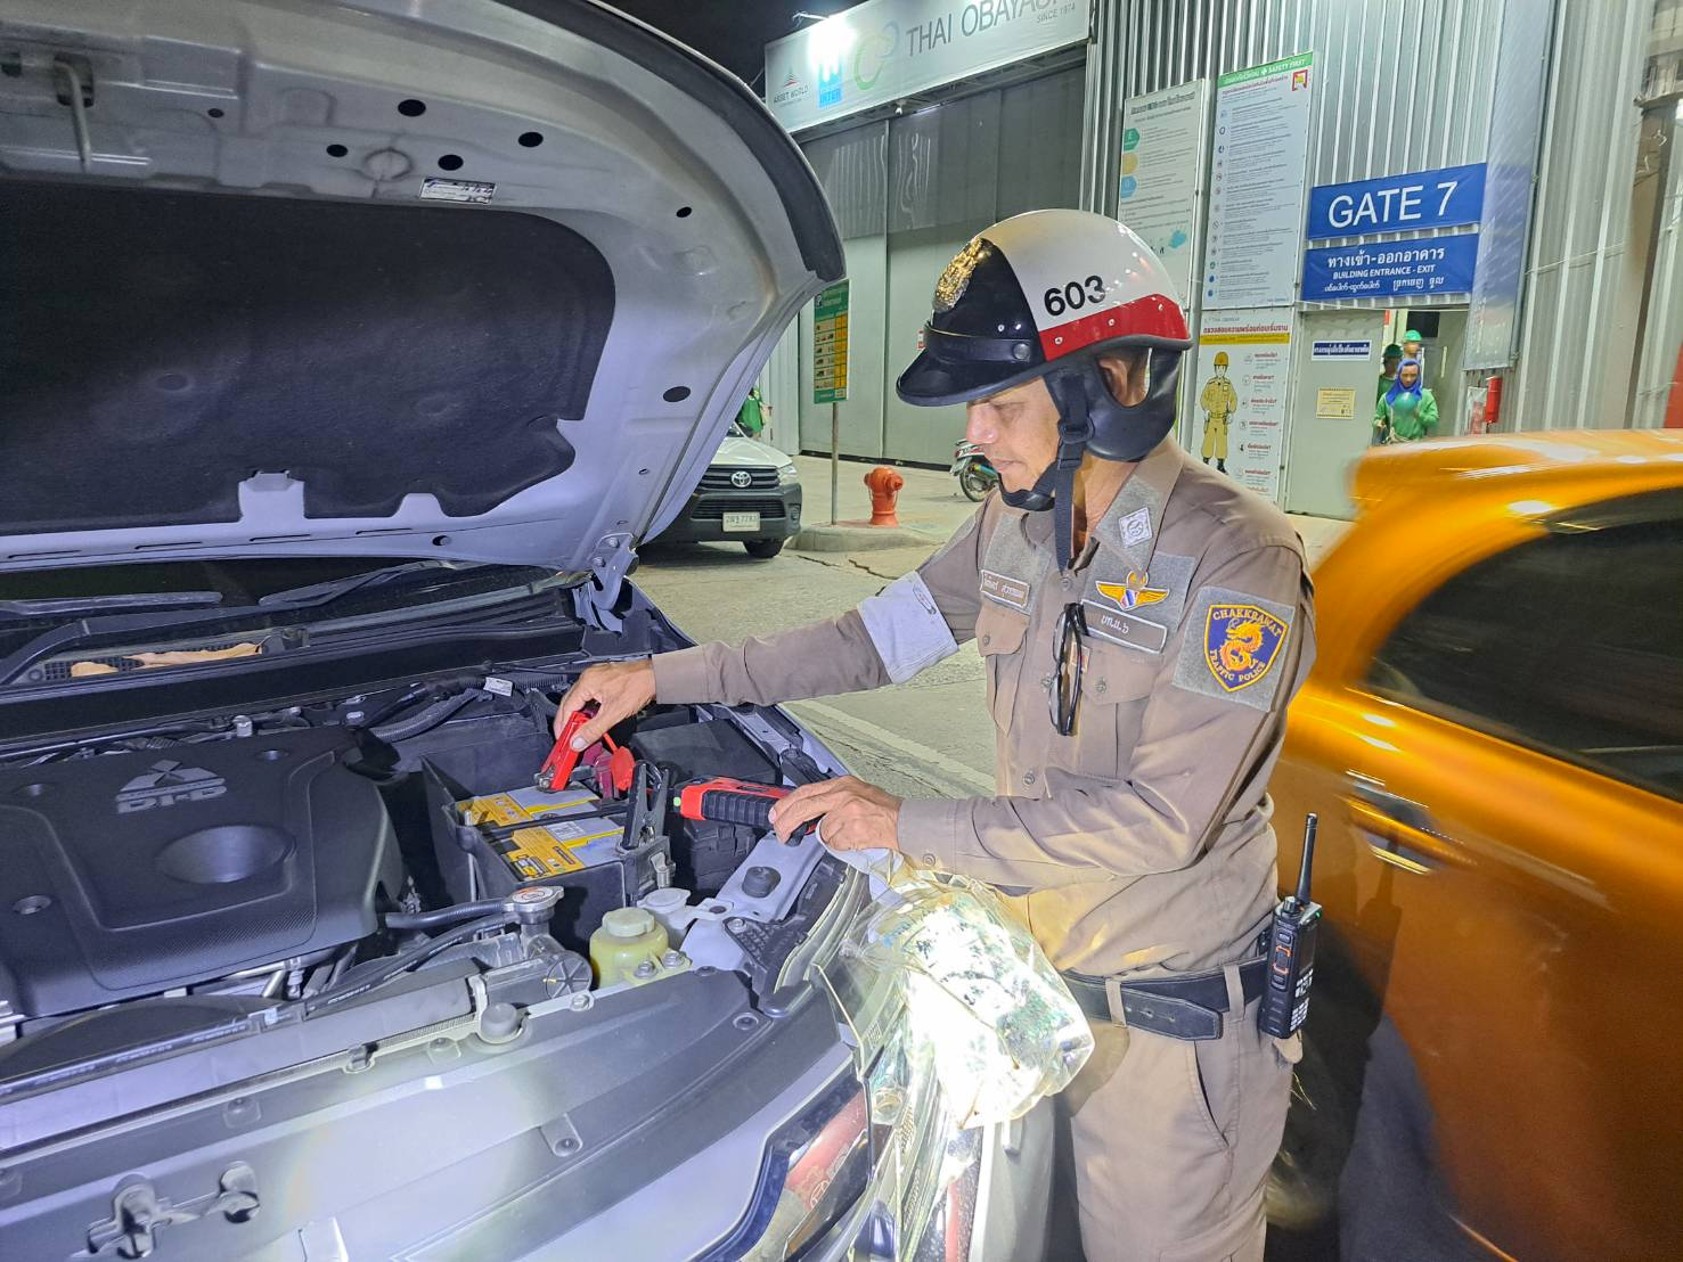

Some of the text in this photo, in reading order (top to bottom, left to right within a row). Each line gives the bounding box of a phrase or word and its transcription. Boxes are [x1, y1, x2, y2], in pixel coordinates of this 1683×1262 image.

[905, 13, 952, 57] THAI
[1328, 181, 1458, 229] GATE 7
[1328, 247, 1445, 268] ทางเข้า-ออกอาคาร
[1333, 269, 1369, 280] BUILDING
[1370, 266, 1412, 277] ENTRANCE
[1417, 264, 1436, 274] EXIT
[1044, 275, 1106, 316] 603
[1210, 648, 1266, 682] TRAFFIC POLICE
